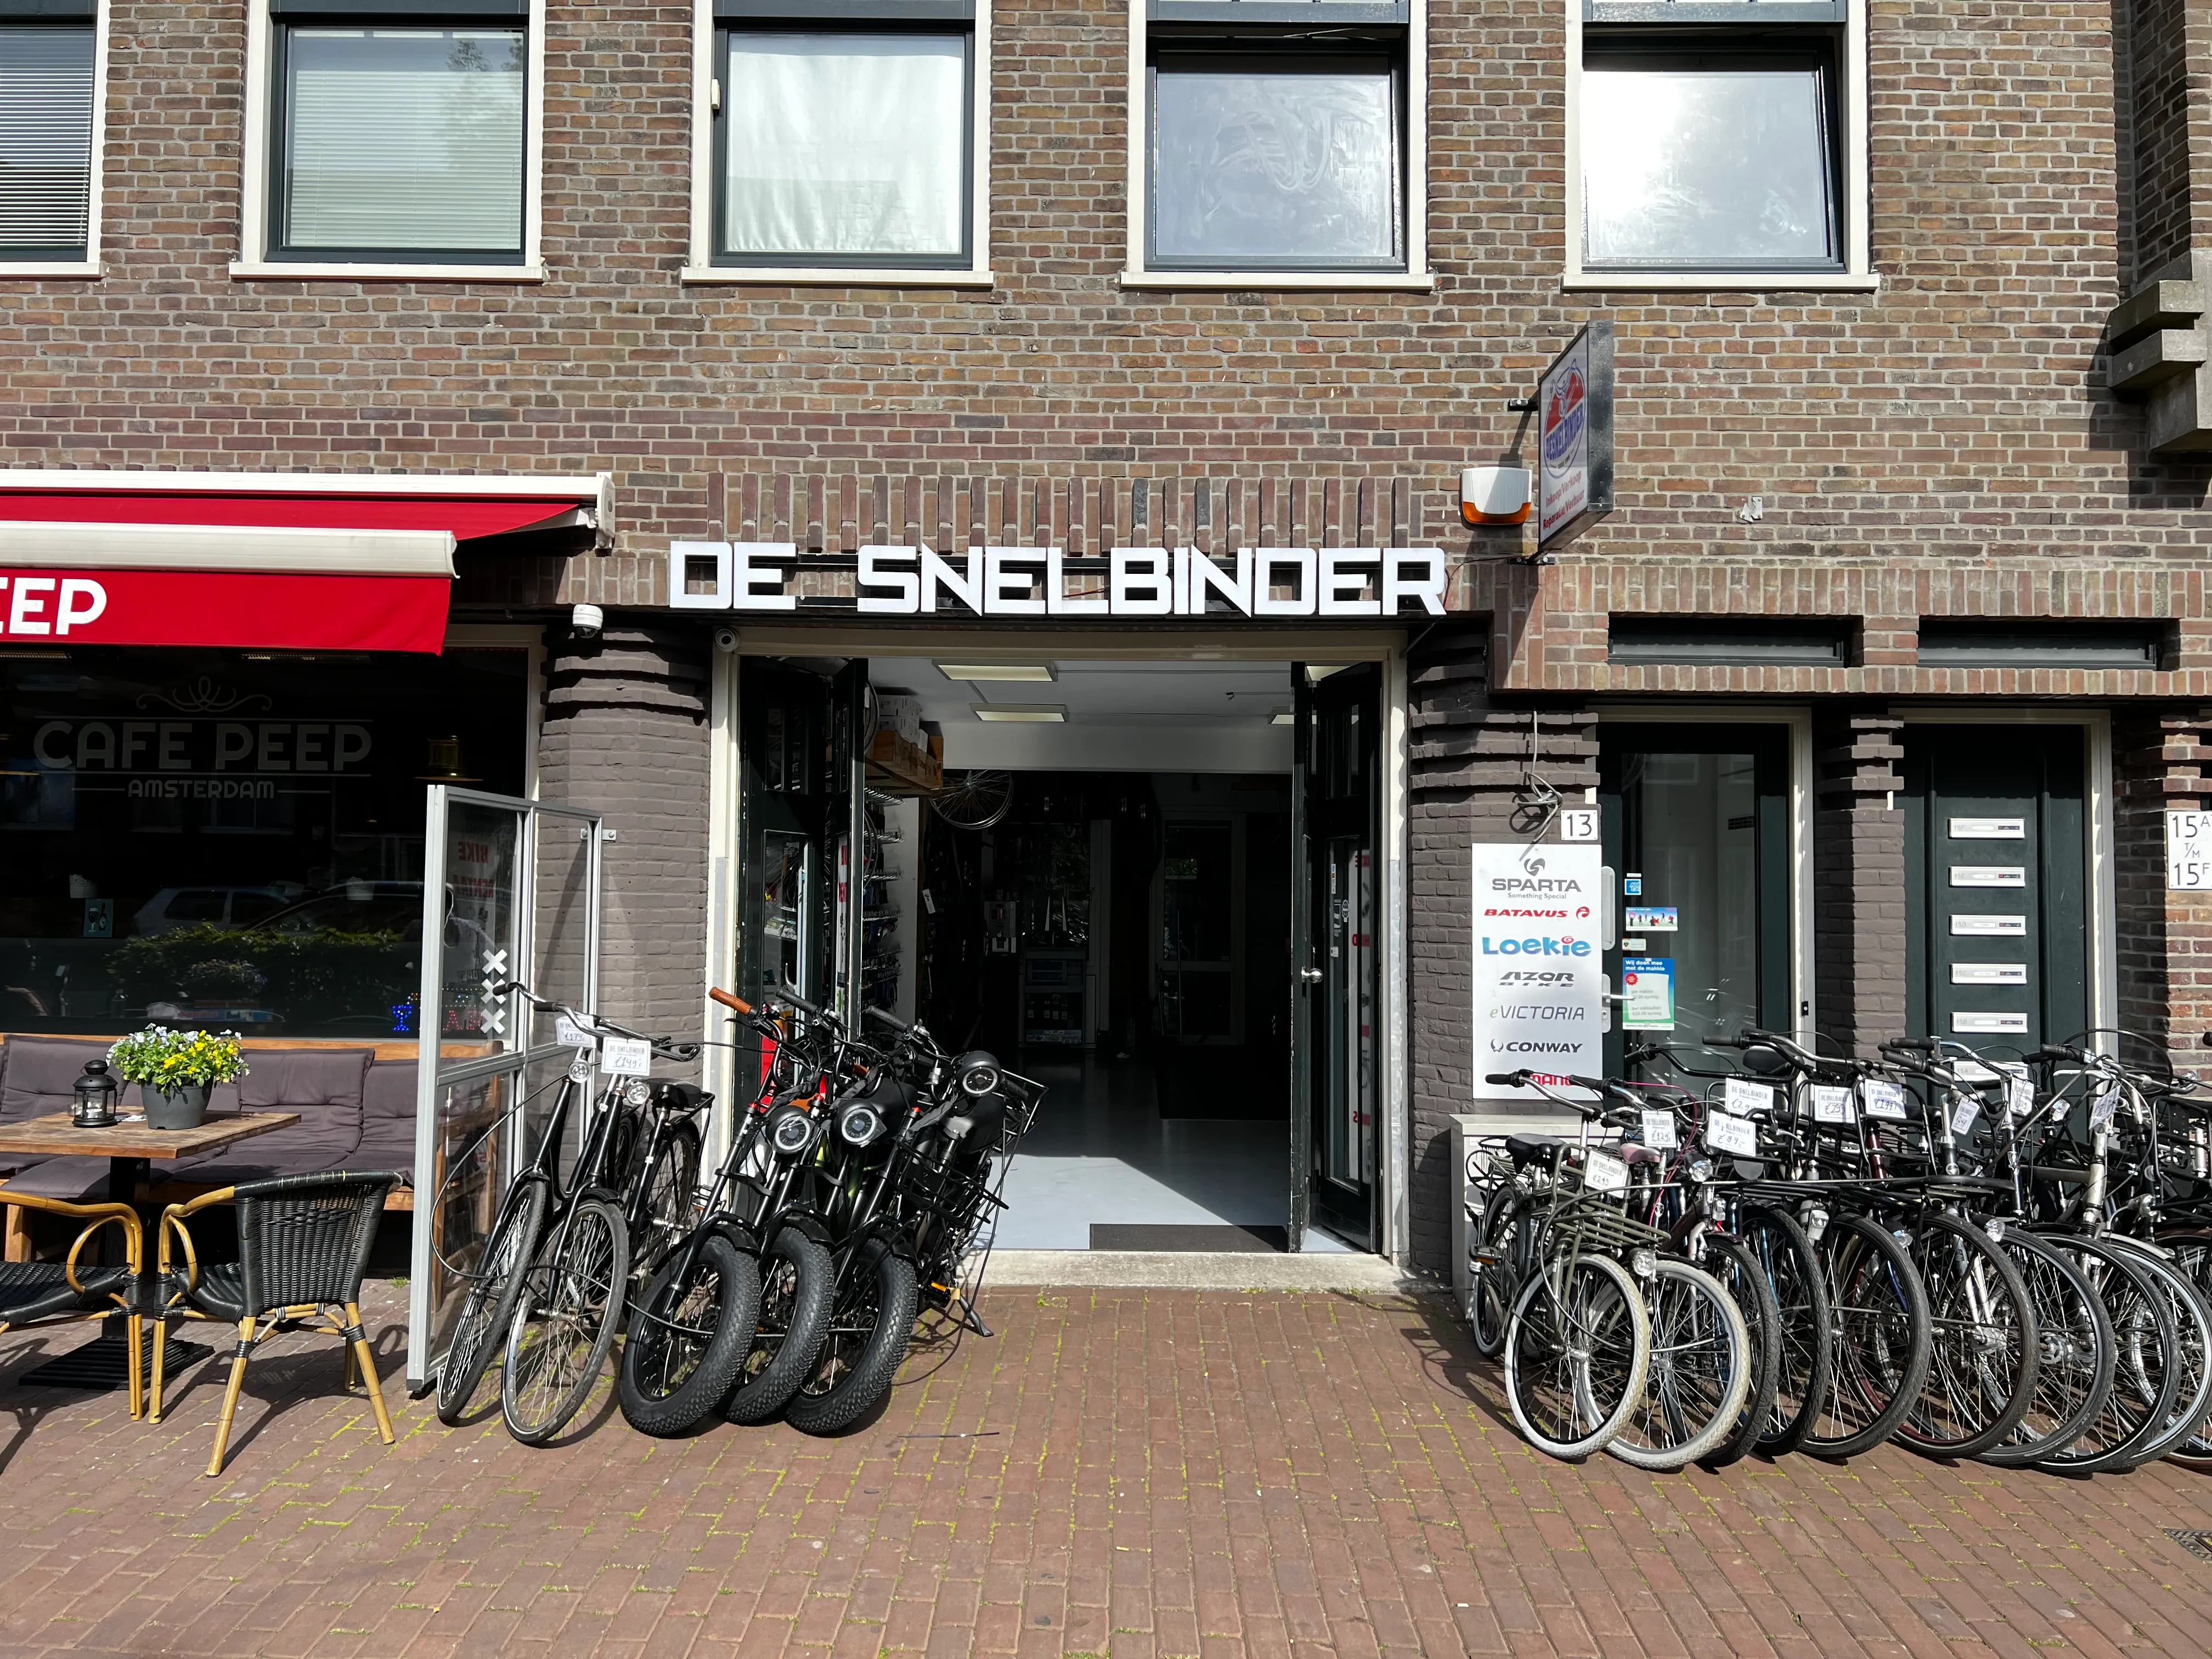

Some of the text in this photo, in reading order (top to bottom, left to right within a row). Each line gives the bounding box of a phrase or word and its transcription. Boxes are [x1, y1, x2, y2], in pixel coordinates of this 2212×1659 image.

[670, 541, 1447, 617] DE SNELBINDER
[0, 577, 107, 635] EP
[33, 720, 373, 771] CAFE PEEP
[128, 779, 275, 799] AMSTERDAM
[1566, 814, 1592, 837] 13
[1492, 878, 1582, 892] SPARTA
[1484, 909, 1568, 917] BATAVUS
[1482, 935, 1592, 957] Loekie
[1499, 972, 1575, 981] AZOR
[1489, 1005, 1584, 1020] eVICTORIA
[617, 1046, 645, 1054] SNELBINDER
[1506, 1042, 1583, 1053] CONWAY
[1739, 1087, 1768, 1099] SNELBINDER
[1722, 1121, 1750, 1135] NELBINDER
[1599, 1161, 1623, 1176] SNELBINDER
